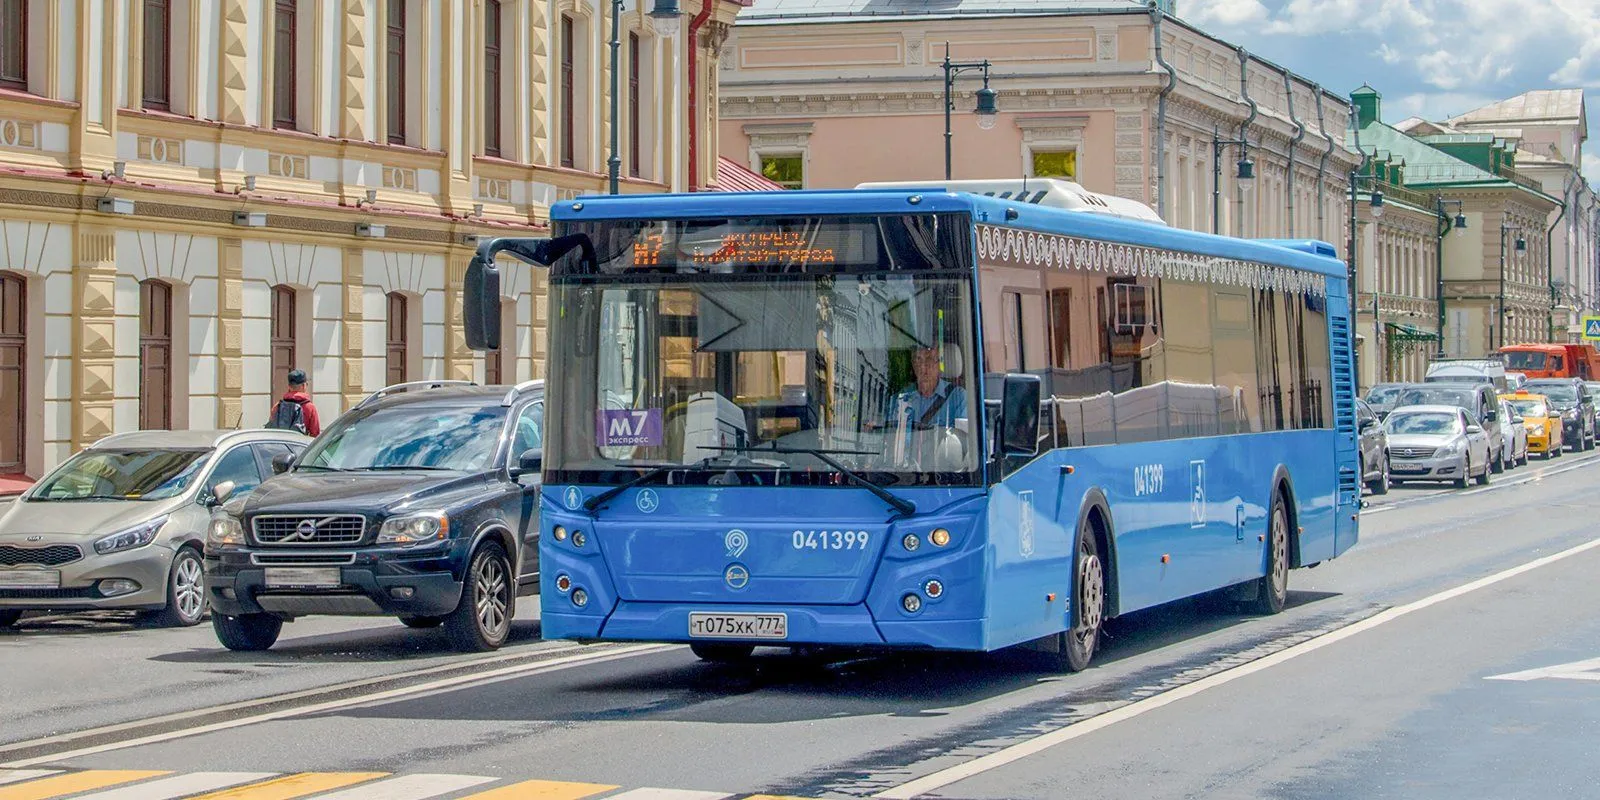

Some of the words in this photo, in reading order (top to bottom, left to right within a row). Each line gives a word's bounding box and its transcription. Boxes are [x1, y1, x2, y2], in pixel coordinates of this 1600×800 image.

[608, 436, 649, 444] экспресс
[1134, 463, 1163, 497] 041399
[792, 530, 869, 550] 041399
[758, 617, 780, 630] 777
